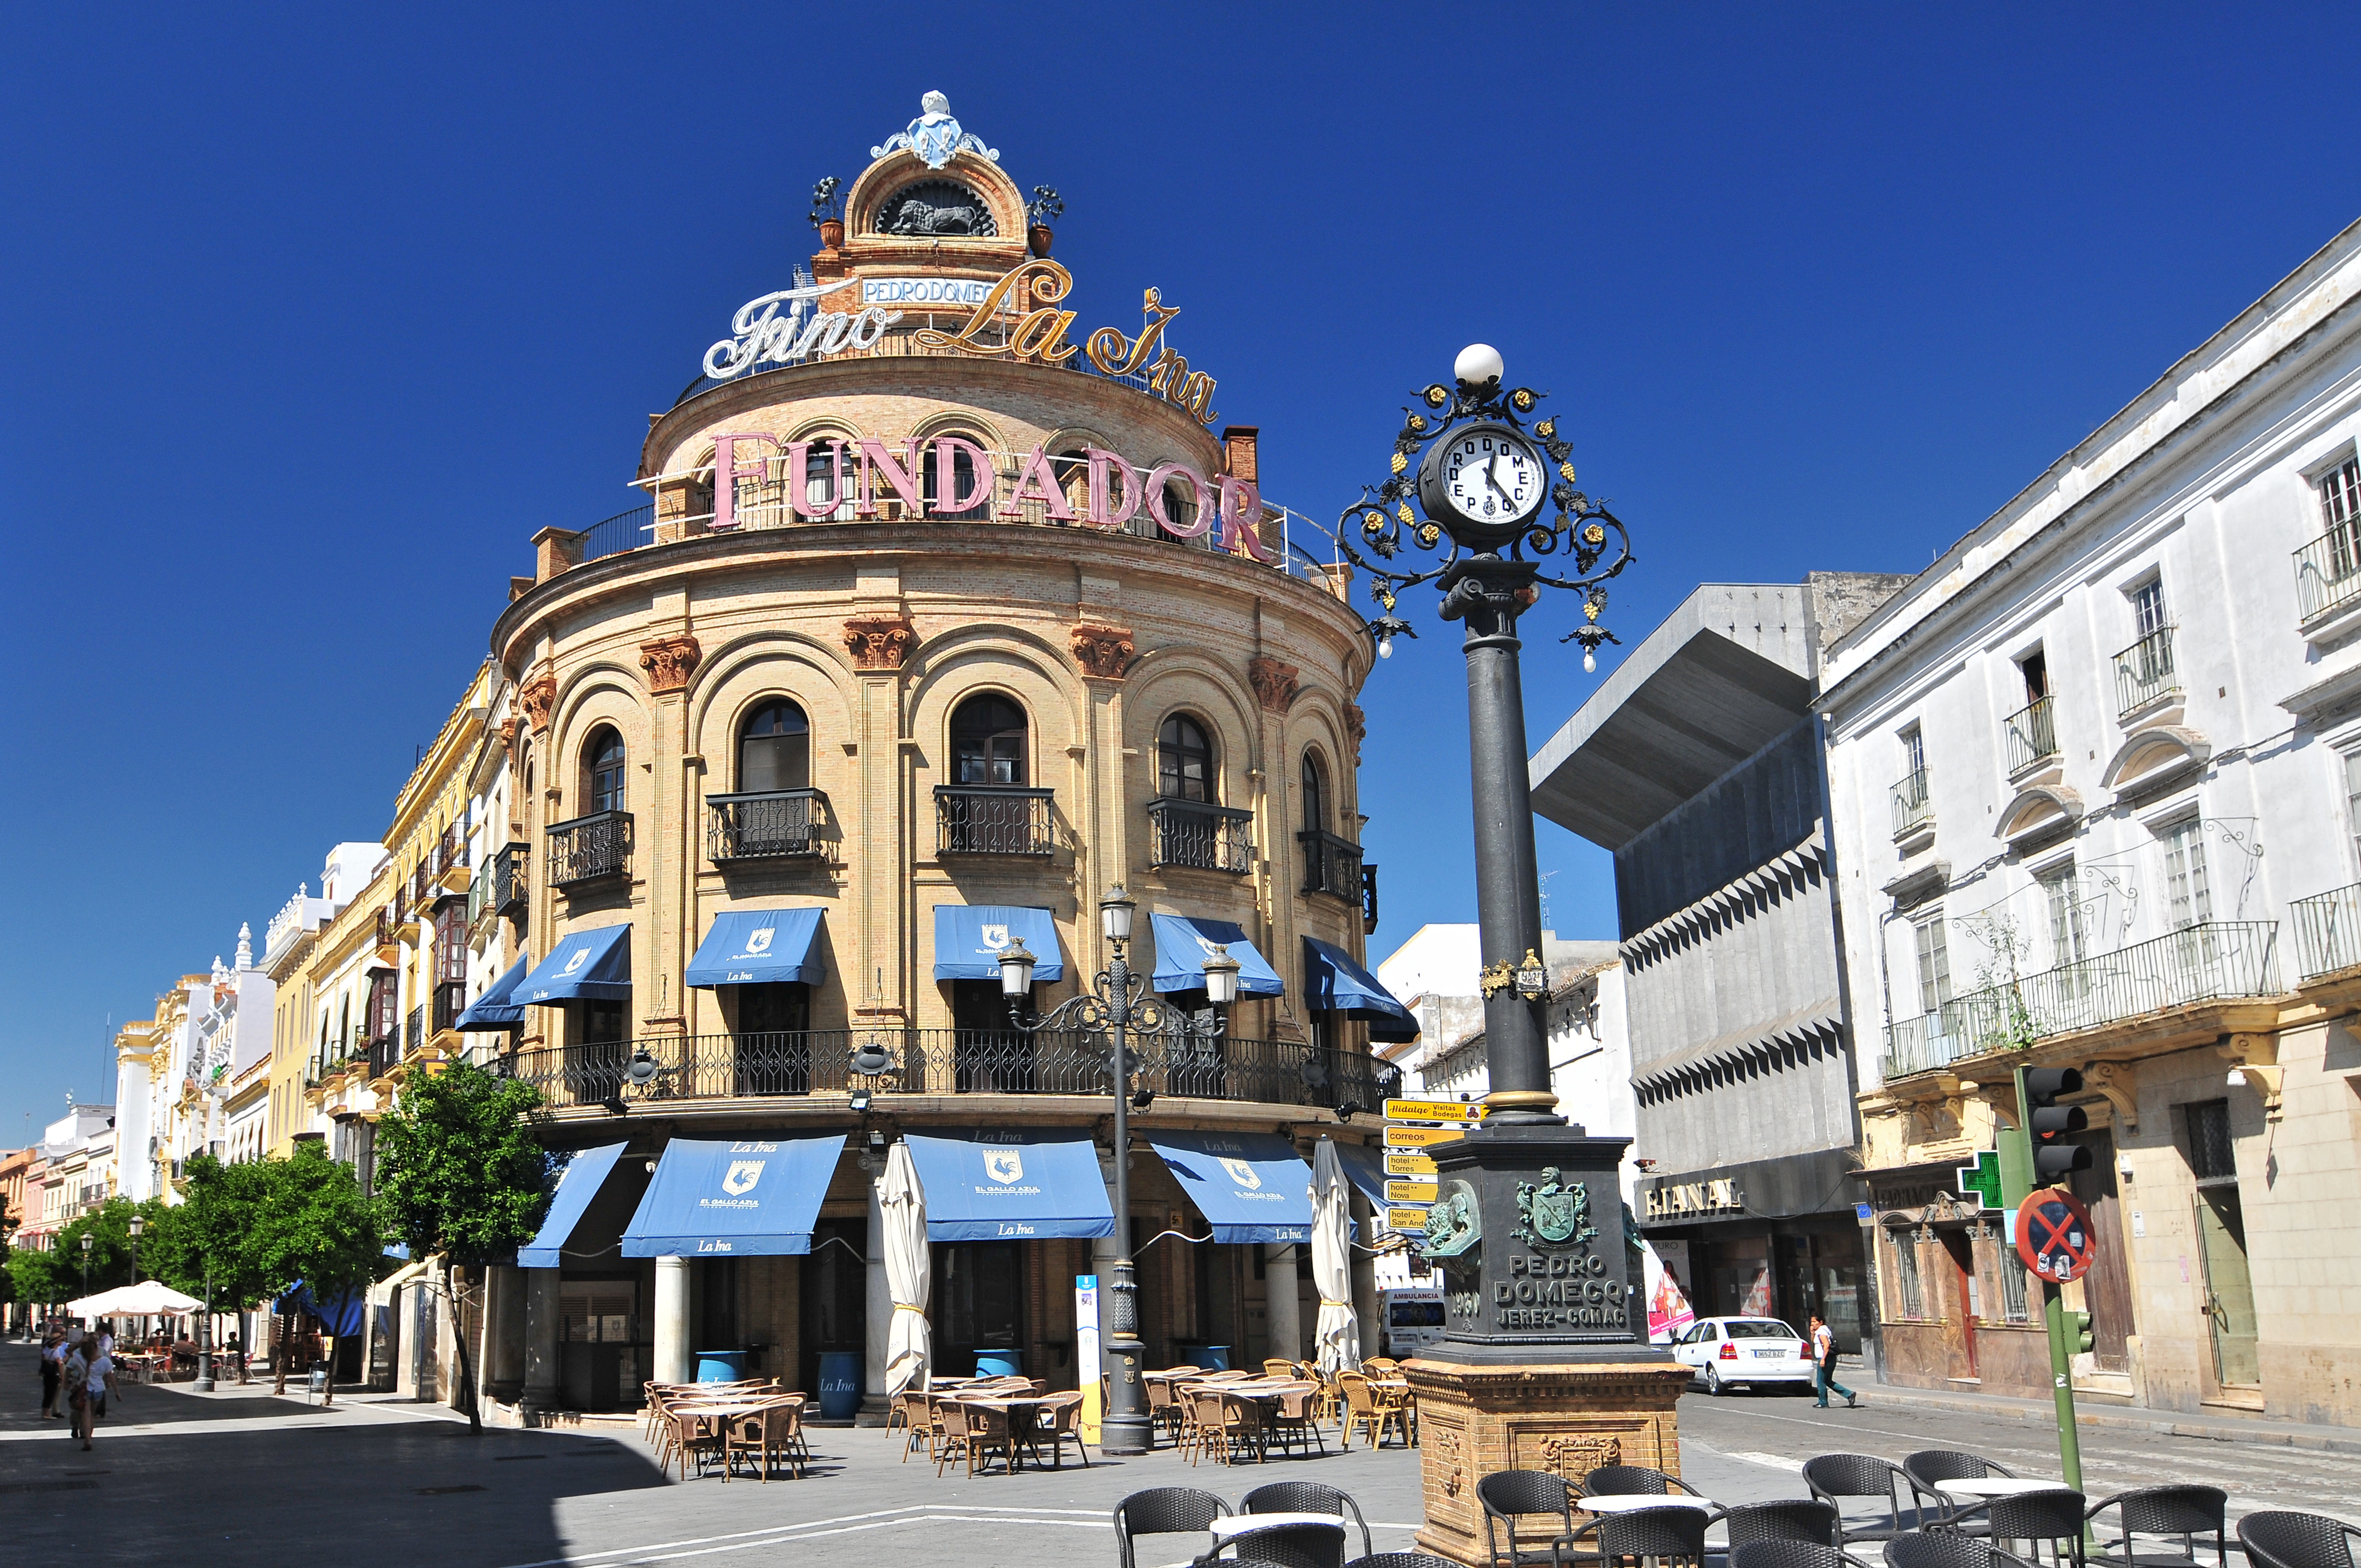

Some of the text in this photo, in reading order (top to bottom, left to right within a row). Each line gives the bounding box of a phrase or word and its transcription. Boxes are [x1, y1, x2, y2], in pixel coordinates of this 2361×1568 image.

[864, 281, 928, 302] PEDRO
[703, 258, 1220, 425] Fino La Ina
[707, 431, 1273, 561] FUNDADOR
[726, 971, 753, 981] La Ina
[986, 967, 1000, 977] La
[1389, 1105, 1428, 1115] Hidalgo
[974, 1130, 1023, 1142] La Ina
[729, 1141, 778, 1153] La Ina
[1204, 1140, 1222, 1151] La
[997, 1223, 1035, 1235] La Ina
[1275, 1228, 1303, 1239] La Ina
[697, 1239, 732, 1252] La Ina
[1653, 1242, 1678, 1250] PURO
[1509, 1255, 1606, 1275] PEDRO
[1494, 1280, 1624, 1304] DOMECQ
[820, 1379, 855, 1391] La Ina
